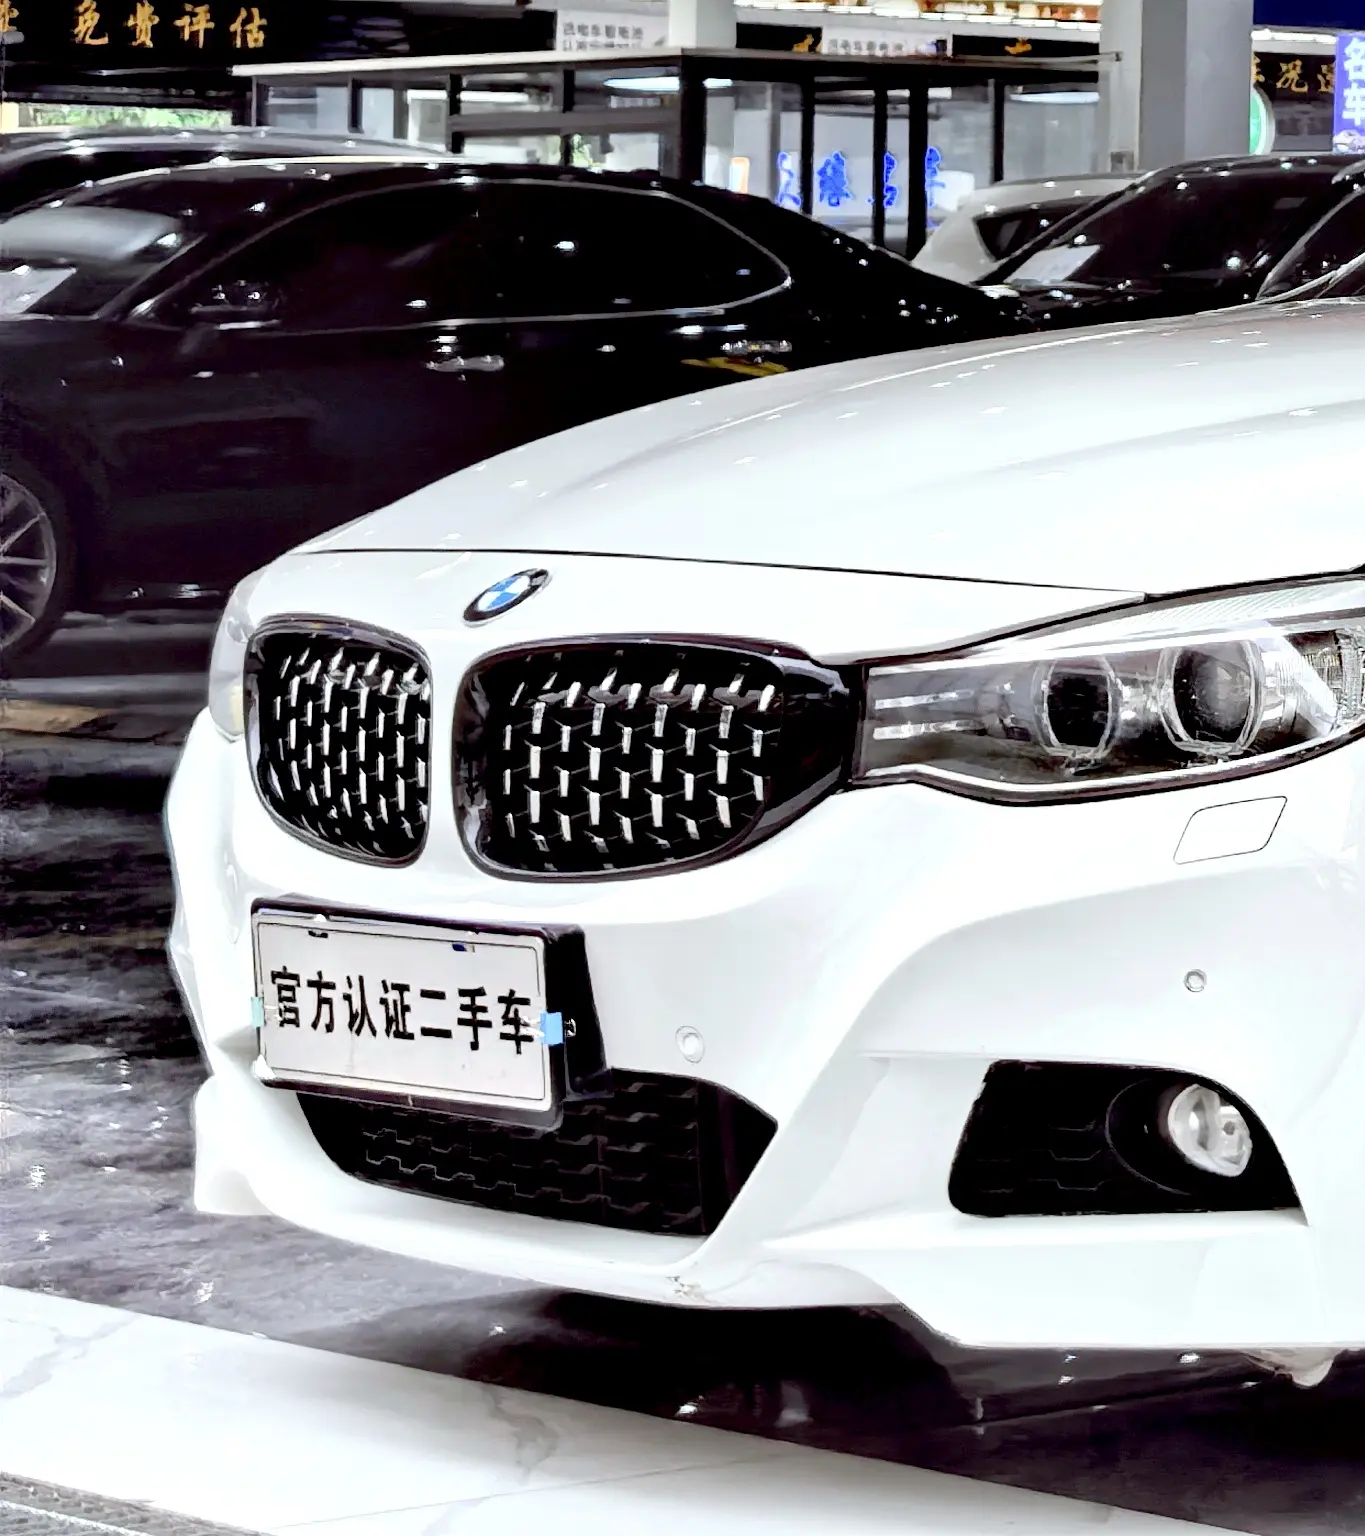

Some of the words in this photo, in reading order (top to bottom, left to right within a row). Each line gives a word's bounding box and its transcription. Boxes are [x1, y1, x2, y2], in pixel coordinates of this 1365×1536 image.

[270, 965, 535, 1055] 官方认证二手车
